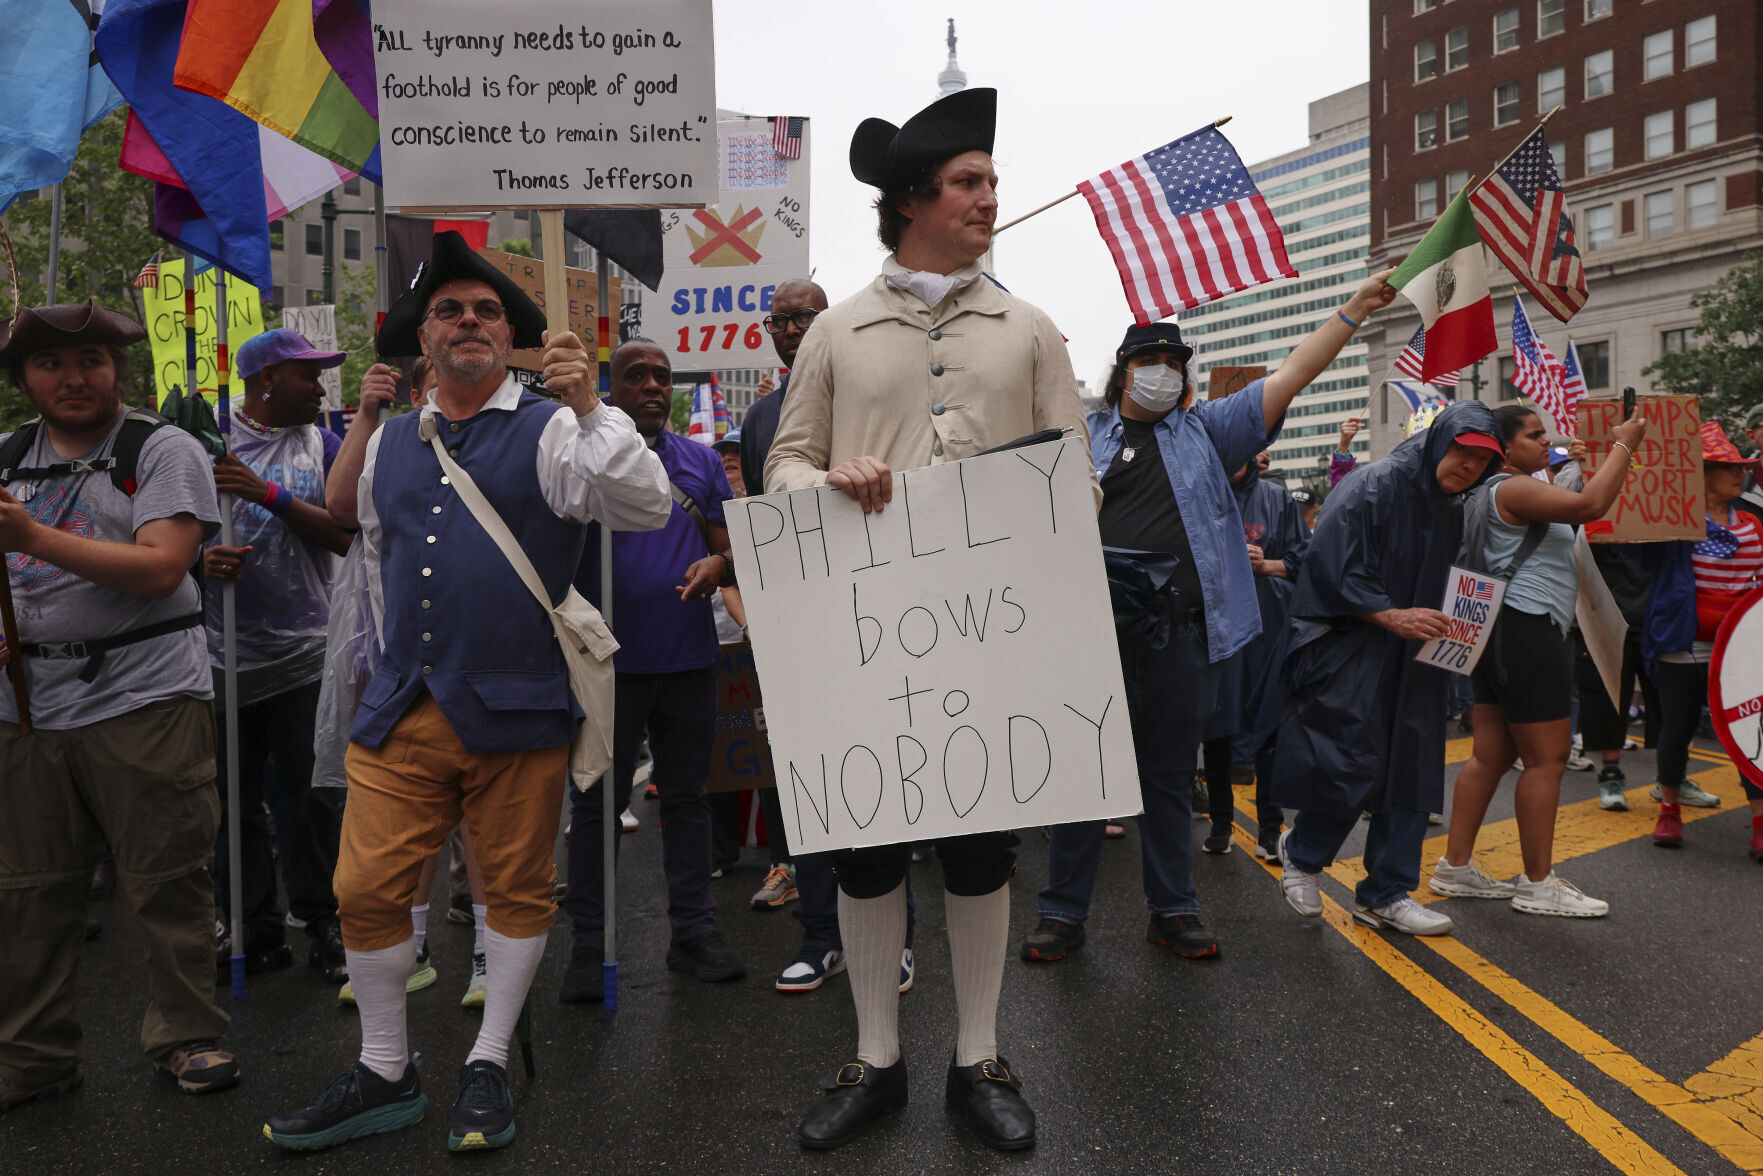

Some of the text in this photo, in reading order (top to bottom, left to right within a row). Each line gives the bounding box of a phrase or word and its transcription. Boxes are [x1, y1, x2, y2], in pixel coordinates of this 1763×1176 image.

[422, 30, 505, 58] tyranny
[513, 24, 574, 52] needs
[578, 25, 606, 49] to
[612, 28, 656, 56] gain
[662, 31, 682, 49] a
[382, 72, 678, 107] foothold is for people of good
[391, 120, 513, 147] conscience
[518, 120, 546, 145] to
[556, 123, 619, 143] remain
[492, 166, 693, 191] Thomas Jefferson
[779, 196, 801, 213] NO
[774, 208, 806, 238] KINGS
[506, 262, 587, 290] TRP
[671, 284, 776, 315] SINCE
[196, 337, 218, 354] HE
[162, 353, 234, 392] CLO
[1577, 399, 1700, 437] TRMPS
[1582, 468, 1695, 495] PORT
[746, 442, 1067, 591] PHILLY
[1615, 494, 1699, 529] MUSK
[1457, 575, 1477, 597] NO
[853, 582, 1026, 667] bows
[1452, 595, 1490, 624] KINGS
[1445, 618, 1483, 645] SINCE
[1430, 639, 1473, 669] 1776
[888, 675, 970, 728] to
[1738, 698, 1762, 718] NO
[789, 695, 1113, 846] NOBODY
